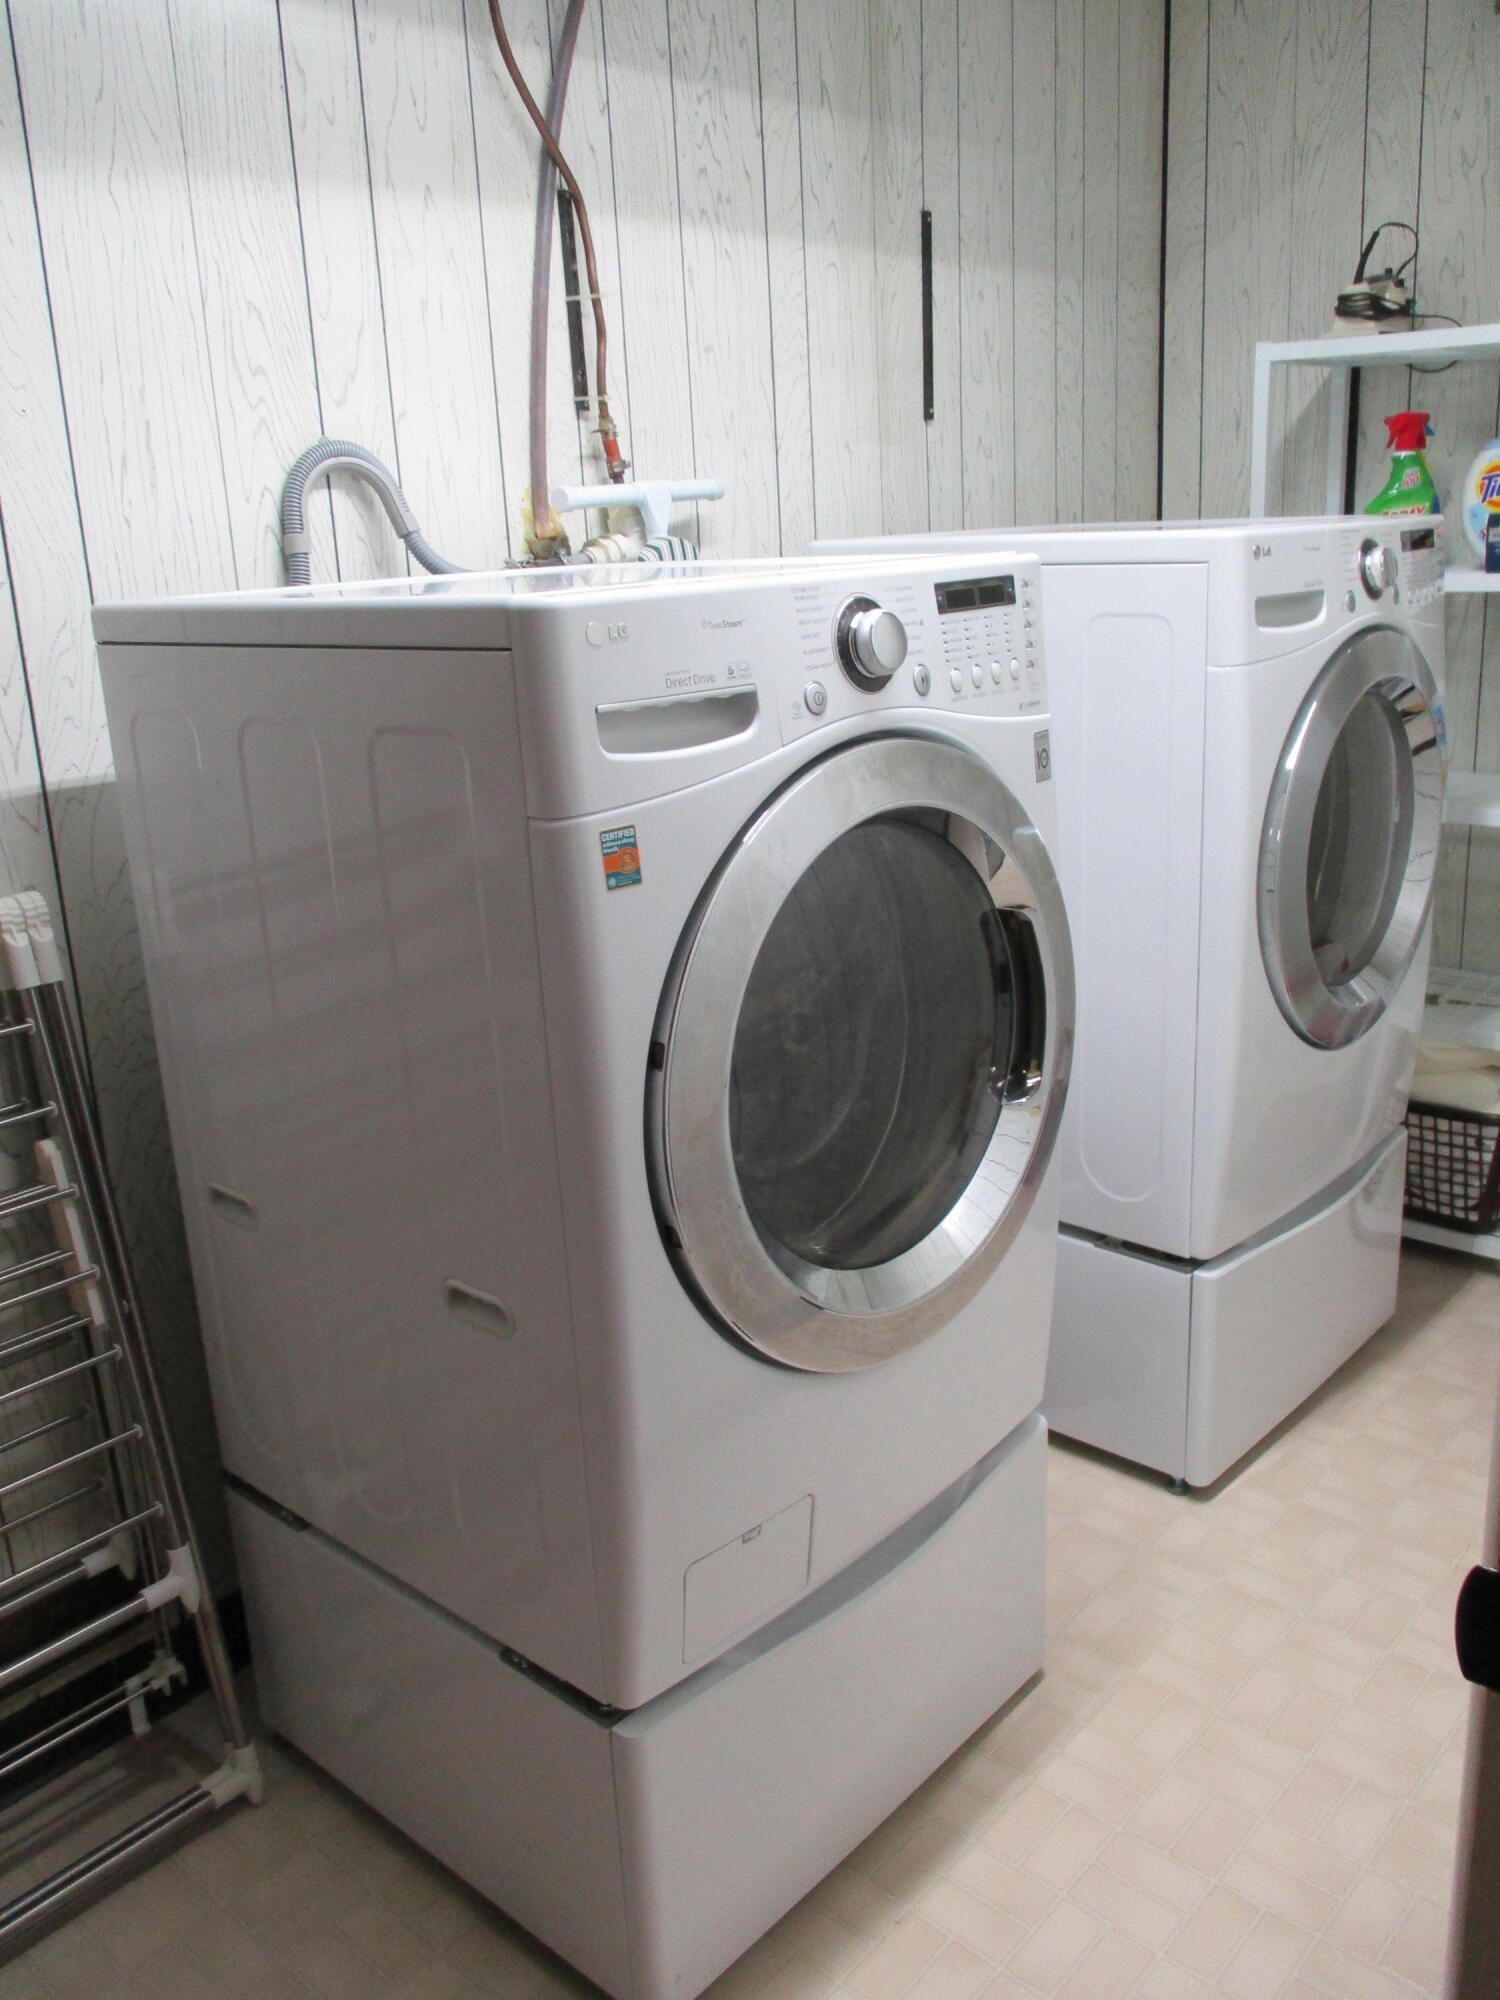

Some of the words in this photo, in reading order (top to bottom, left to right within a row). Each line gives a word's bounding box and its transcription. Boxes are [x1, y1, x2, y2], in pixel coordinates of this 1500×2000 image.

[665, 675, 693, 689] Direct
[693, 672, 716, 686] Drive
[601, 828, 634, 842] CERTIFIED
